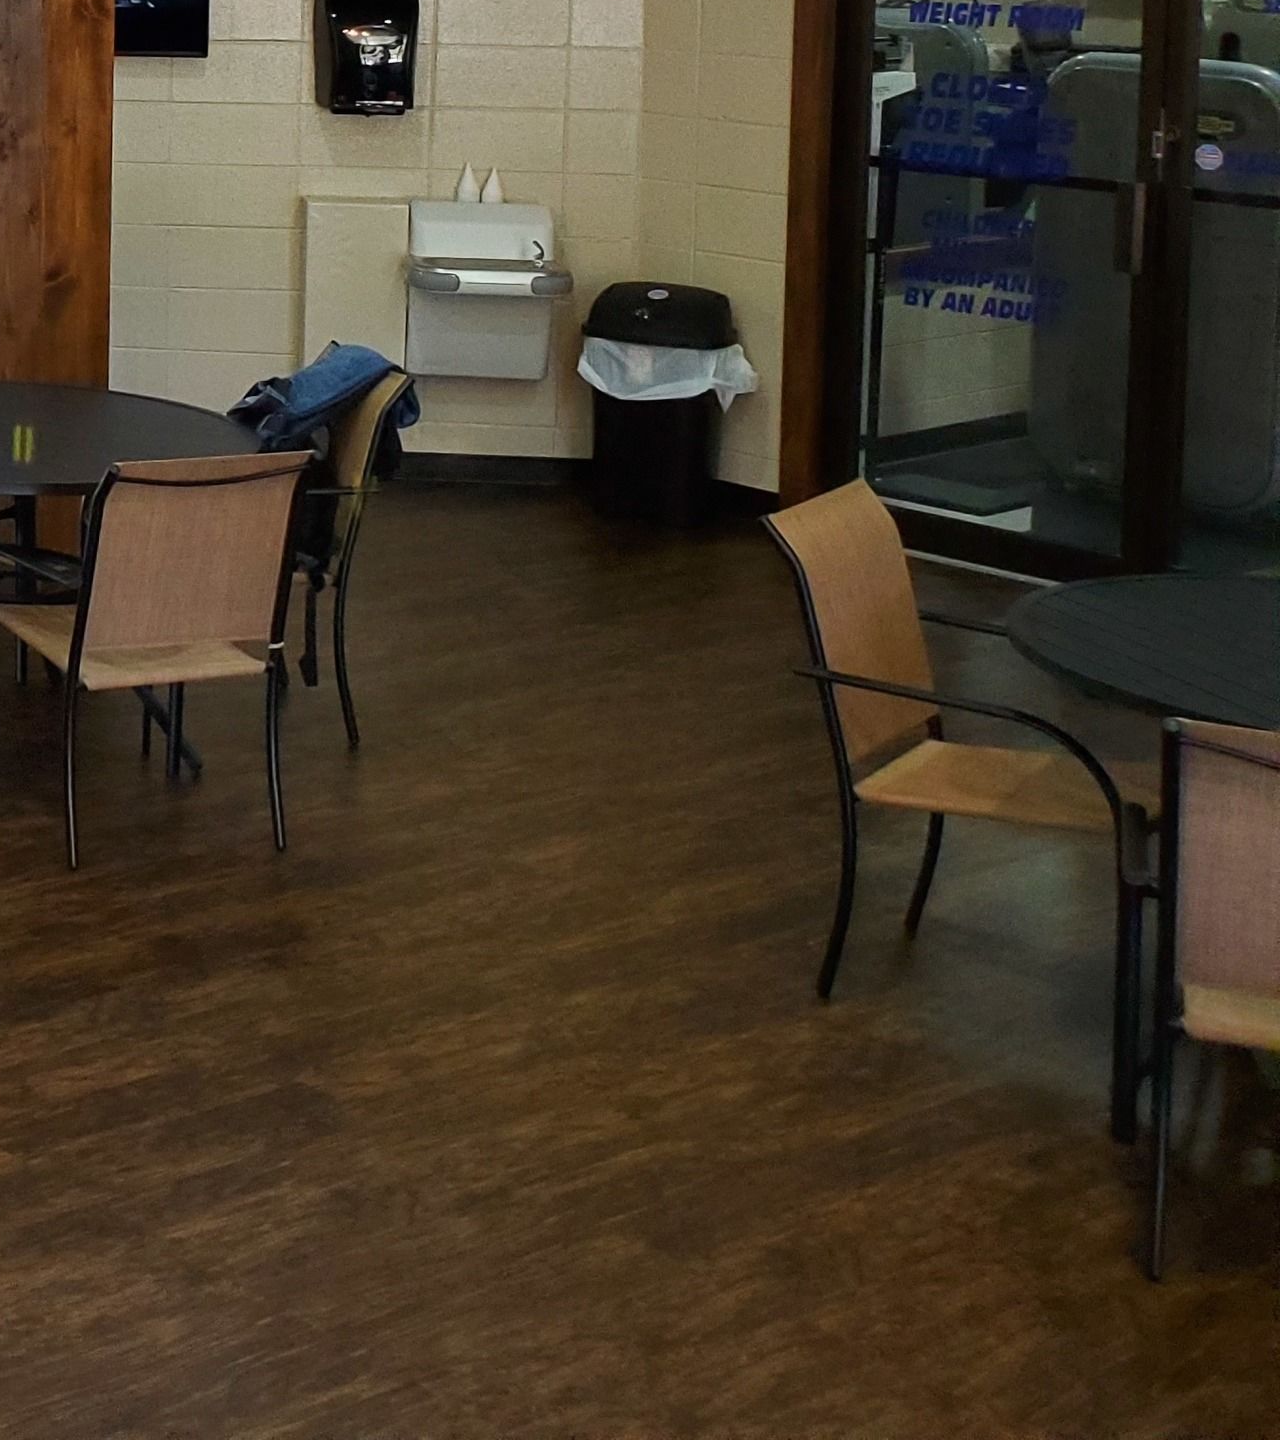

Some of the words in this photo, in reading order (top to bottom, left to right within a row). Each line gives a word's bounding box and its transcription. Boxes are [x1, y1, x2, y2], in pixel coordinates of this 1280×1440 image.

[910, 0, 1002, 28] WEIGHT
[1008, 4, 1085, 31] RM
[903, 286, 936, 308] BY
[941, 291, 975, 314] AN
[980, 297, 1058, 328] ADU
